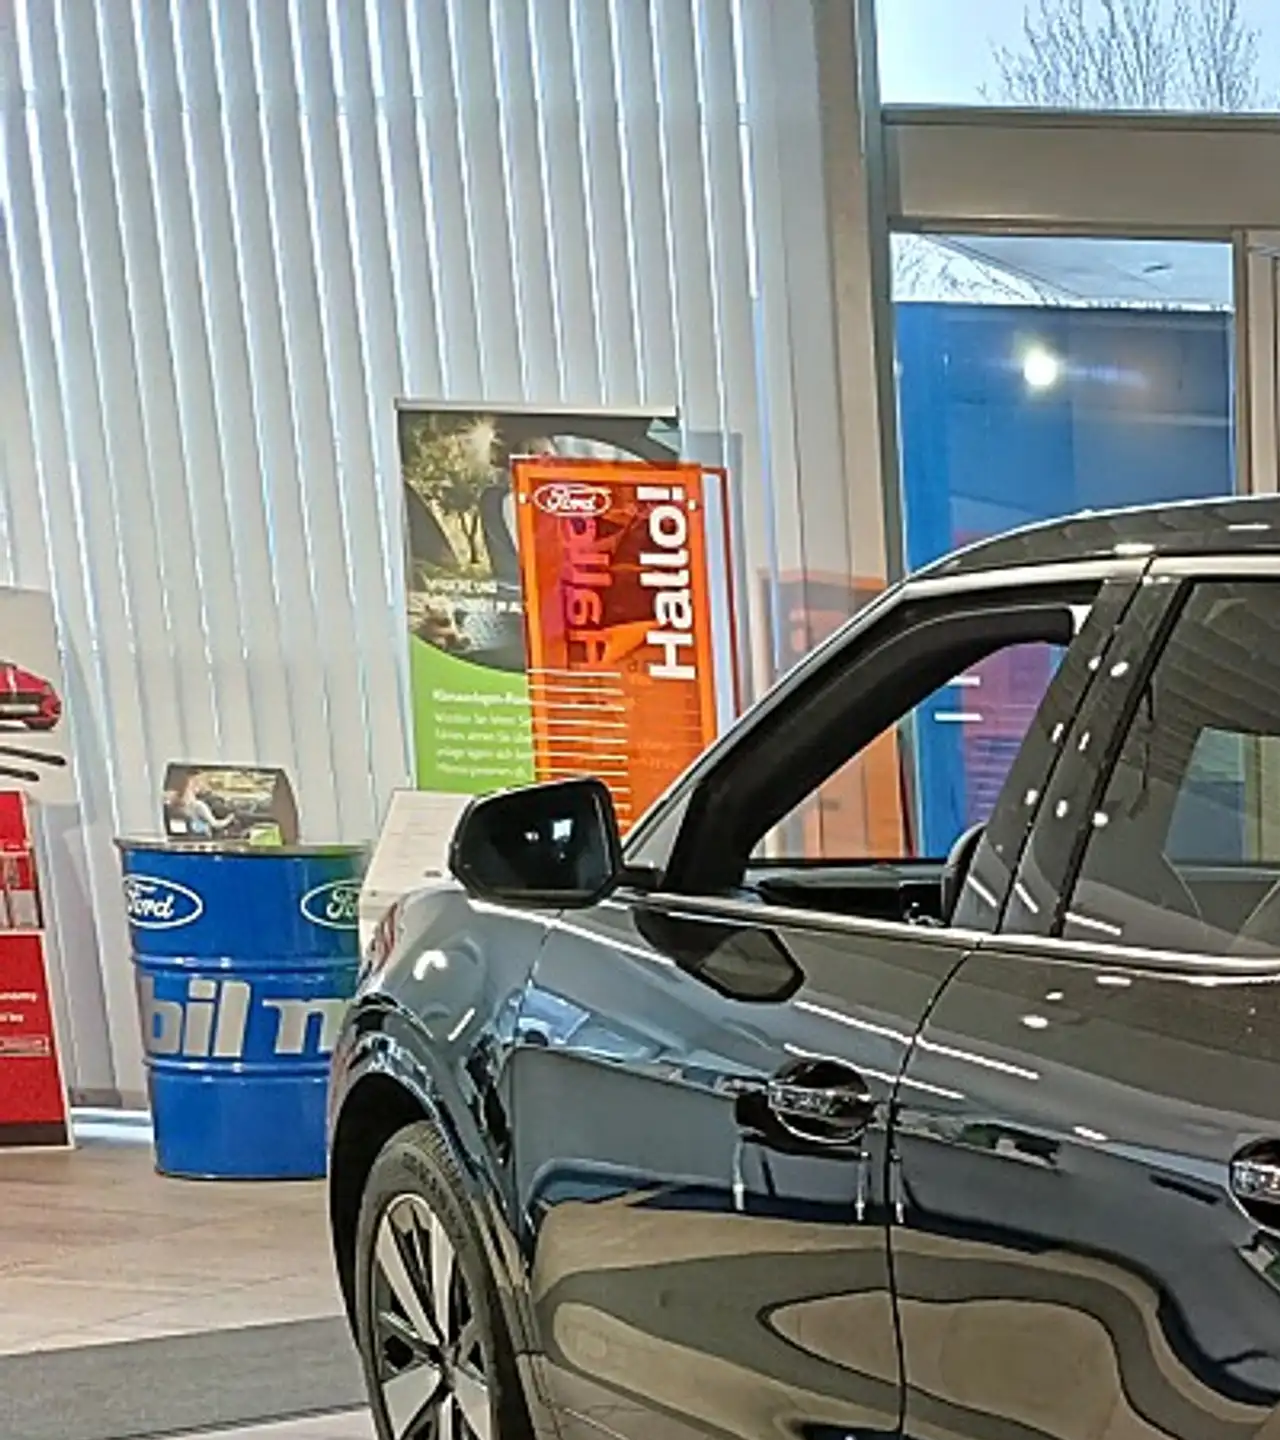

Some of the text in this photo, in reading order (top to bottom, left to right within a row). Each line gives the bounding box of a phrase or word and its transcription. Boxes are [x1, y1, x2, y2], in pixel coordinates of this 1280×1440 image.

[636, 486, 696, 680] Hallo!
[326, 885, 360, 920] Fo
[138, 974, 252, 1058] bil
